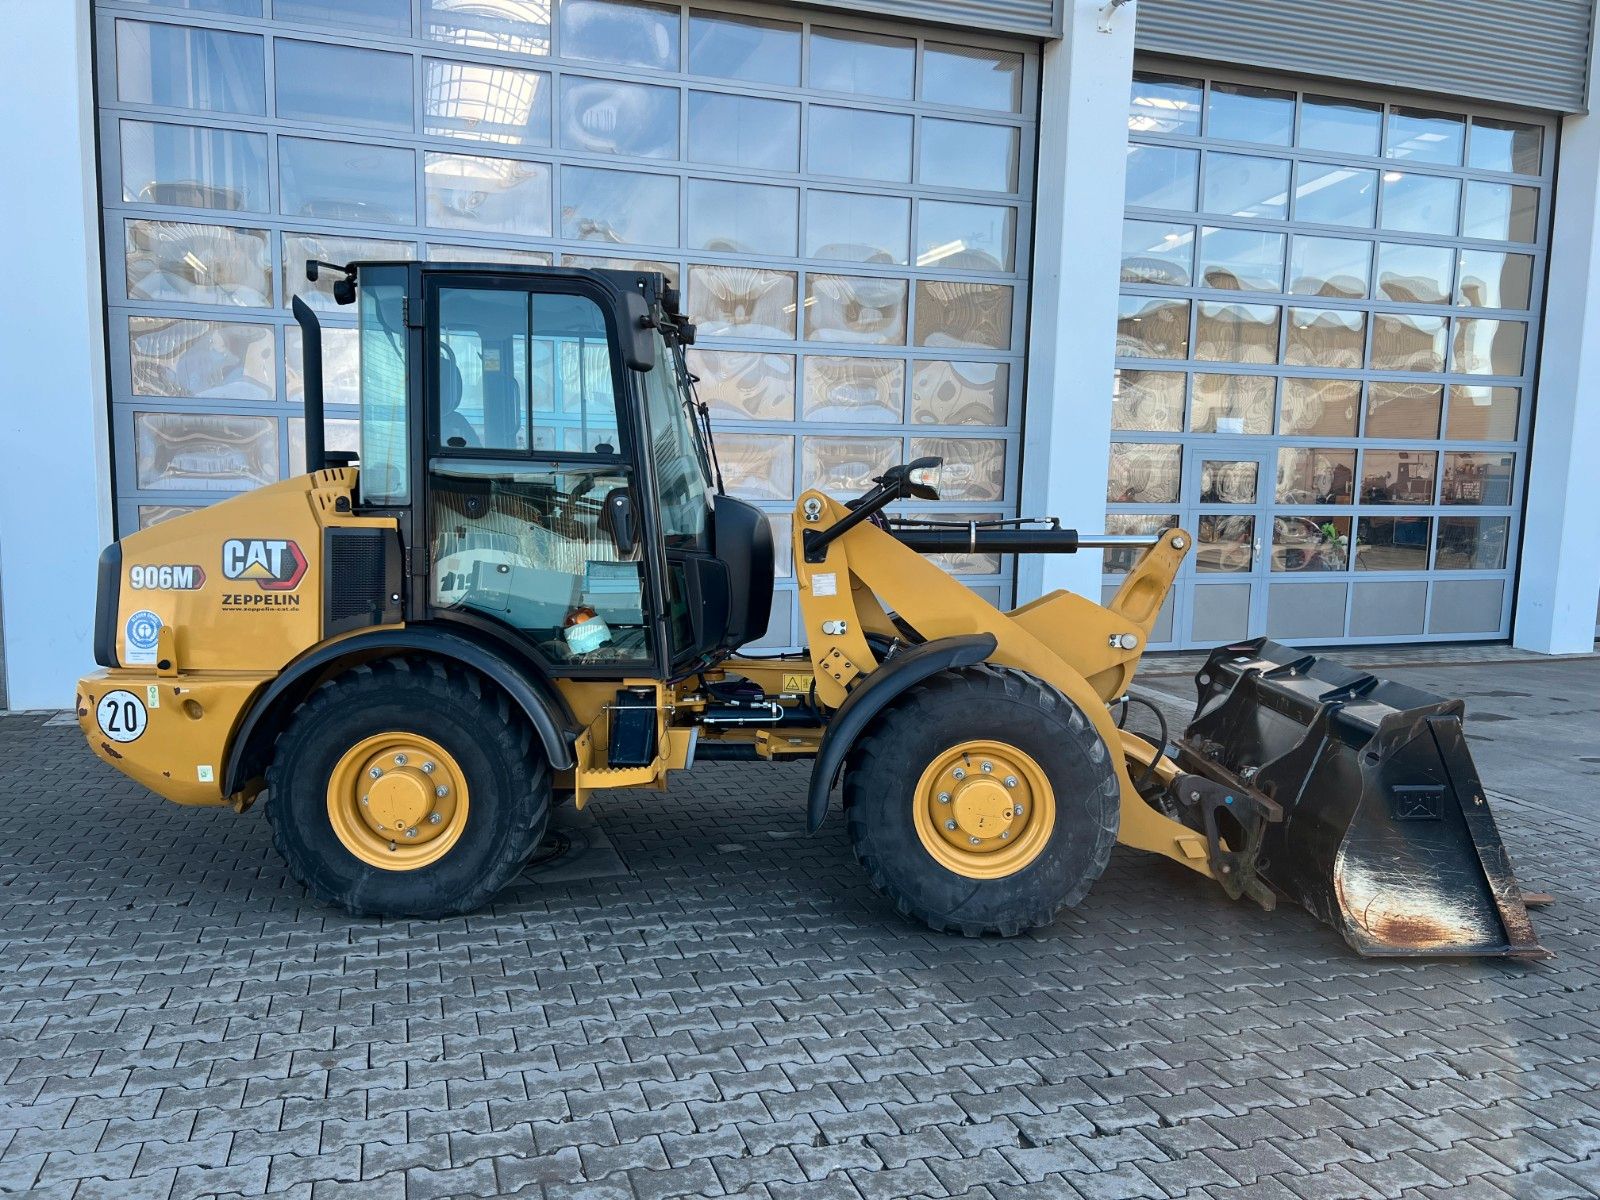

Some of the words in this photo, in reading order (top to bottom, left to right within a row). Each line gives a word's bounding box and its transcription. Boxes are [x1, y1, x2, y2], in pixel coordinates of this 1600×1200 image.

[223, 539, 287, 579] CAT
[131, 566, 193, 589] 906M
[222, 594, 300, 605] ZEPPELIN
[107, 700, 137, 732] 20
